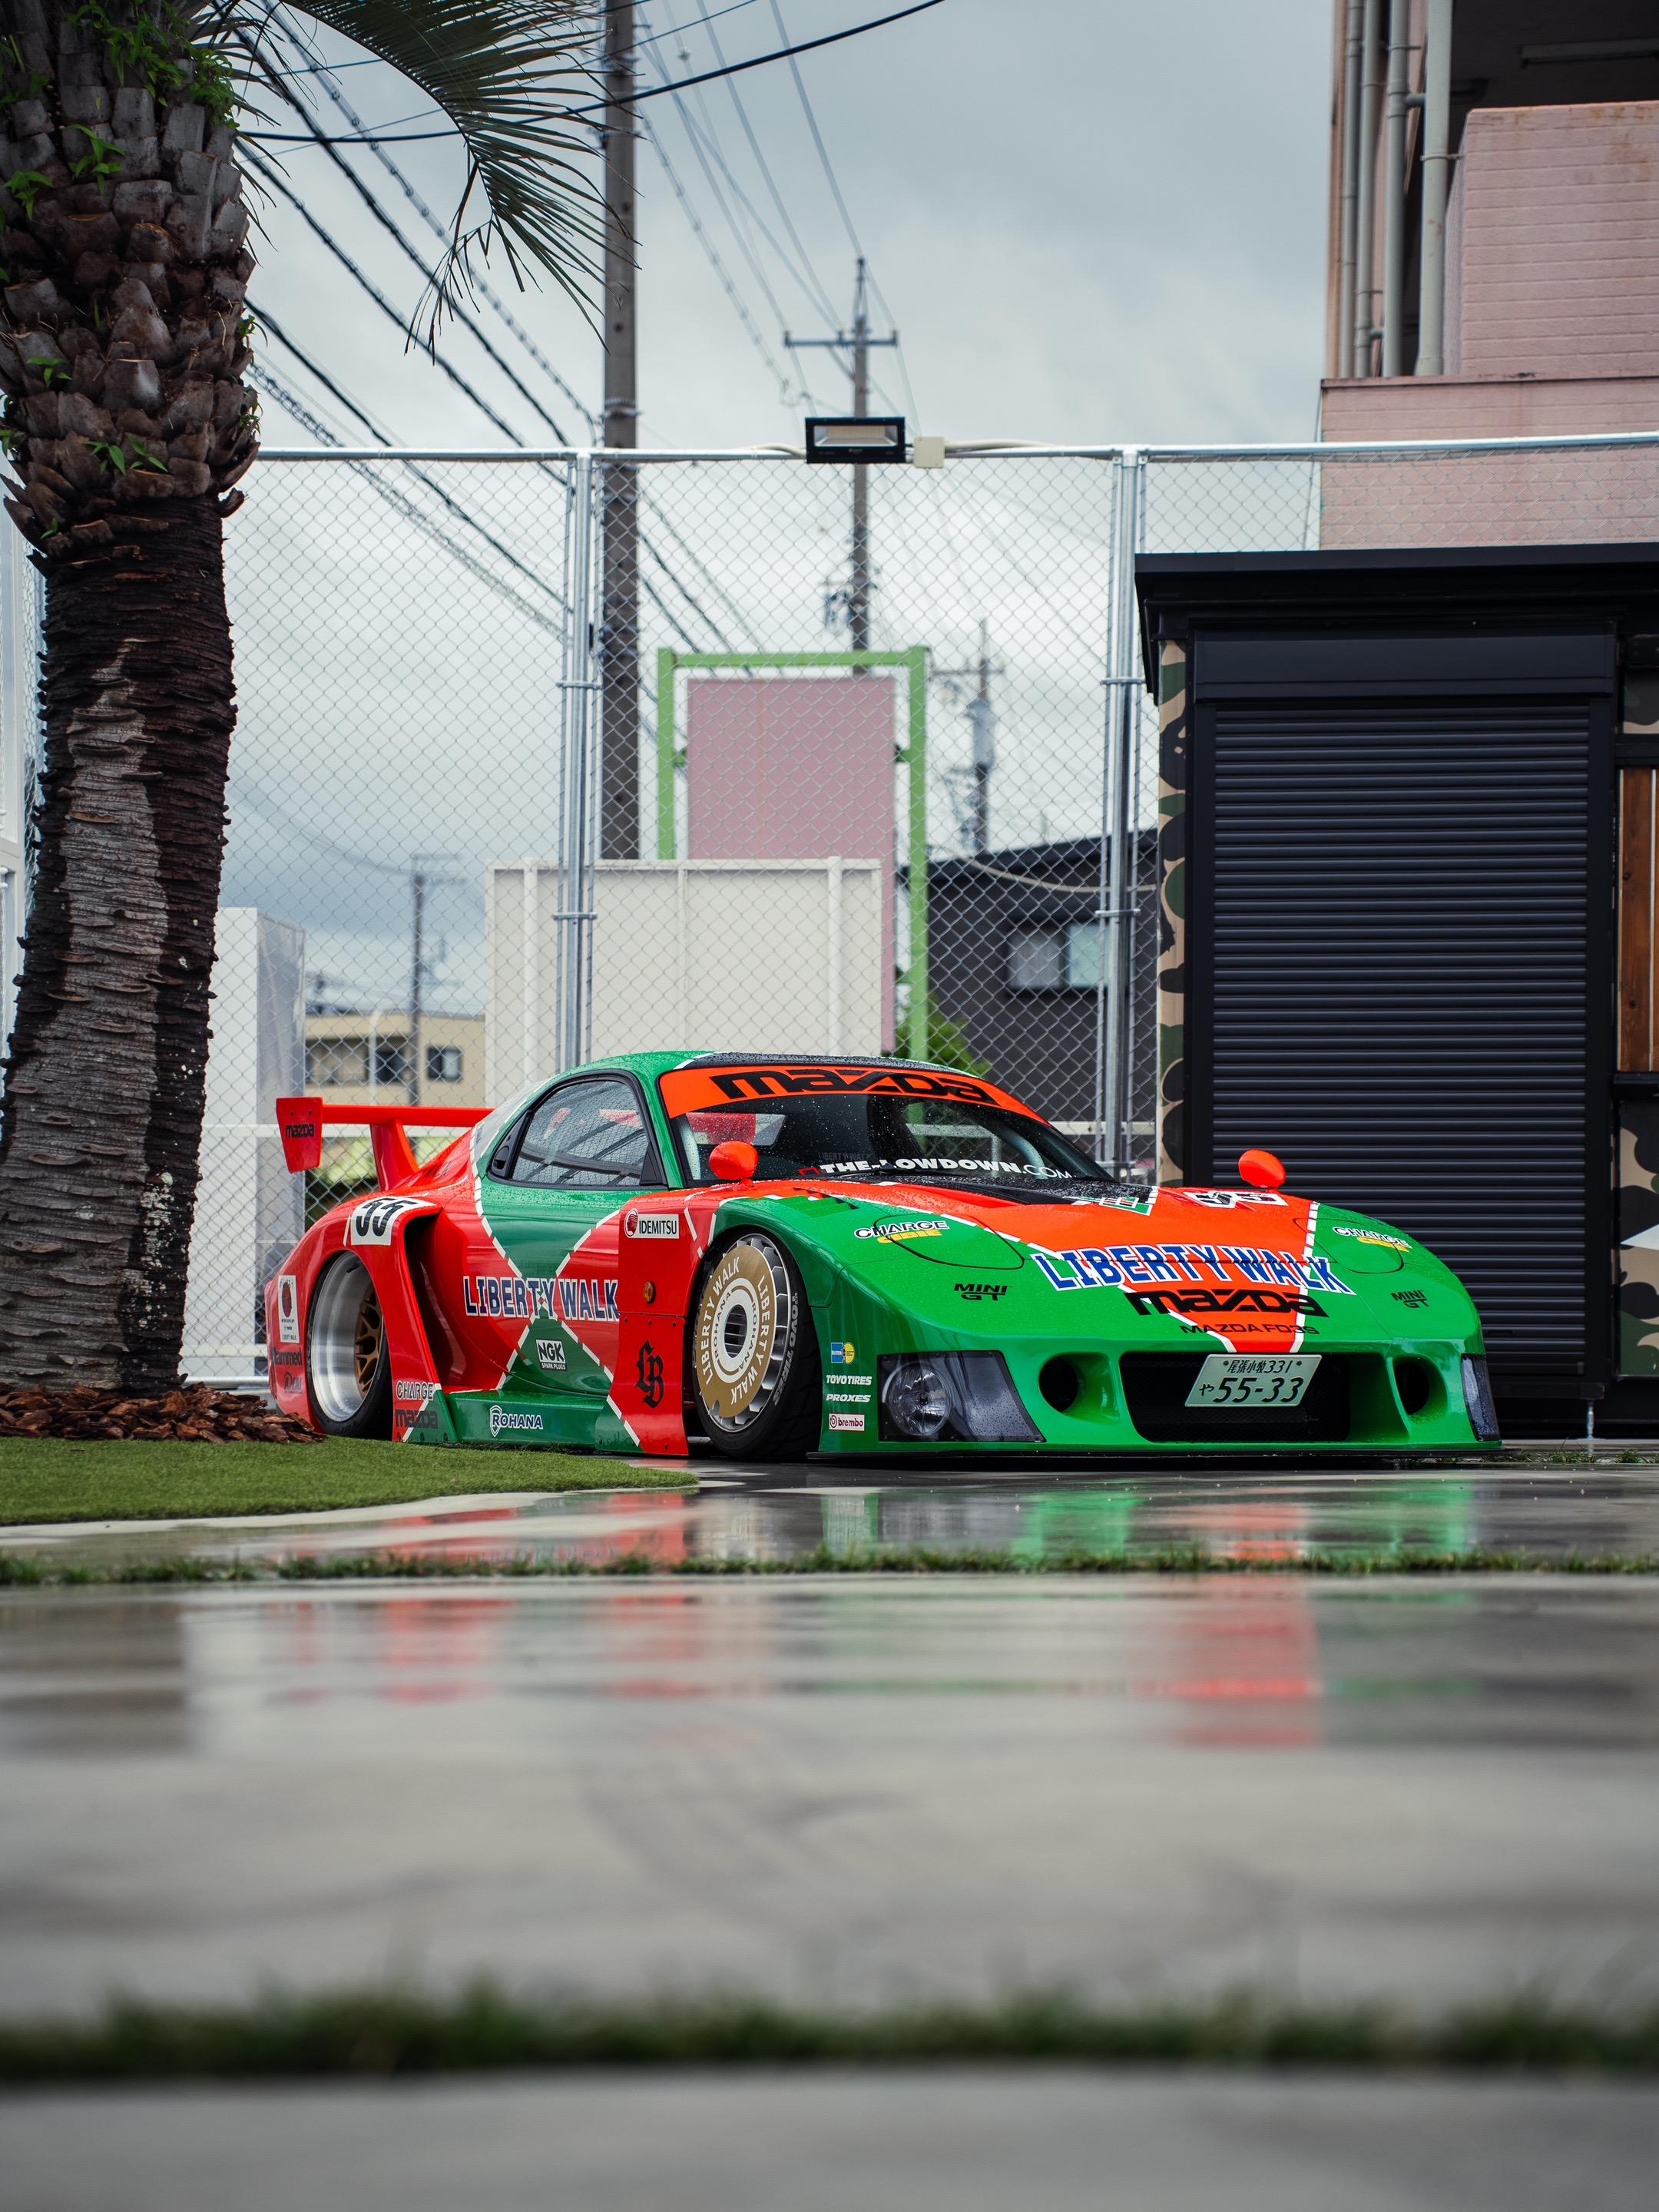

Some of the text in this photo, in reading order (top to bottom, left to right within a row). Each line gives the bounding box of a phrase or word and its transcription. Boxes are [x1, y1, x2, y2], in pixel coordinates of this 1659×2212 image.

[286, 1124, 315, 1138] mazda
[356, 1197, 418, 1237] 55
[639, 1220, 677, 1234] IDEMITSU
[854, 1220, 950, 1239] CHARGE
[1030, 1243, 1357, 1295] LIBERTY WALK
[954, 1283, 1008, 1293] MINI
[961, 1292, 1005, 1300] GT
[1390, 1290, 1428, 1300] MINI
[463, 1276, 620, 1322] LIBERTY WALK
[1403, 1298, 1429, 1308] GT
[701, 1257, 740, 1386] LIBERTY WALK
[714, 1291, 731, 1362] ROHANA
[1180, 1324, 1320, 1335] MAZDA FD3S
[730, 1275, 770, 1405] LIBERTY WALK
[739, 1302, 757, 1371] ROHANA
[538, 1342, 565, 1363] NGK
[396, 1380, 434, 1400] CHARGE
[826, 1375, 872, 1386] TOYO TIRES
[1199, 1377, 1303, 1402] や 55-33
[826, 1394, 871, 1402] PROXES
[395, 1409, 438, 1429] mazda
[492, 1411, 543, 1429] ROHANA
[838, 1417, 863, 1427] brembo
